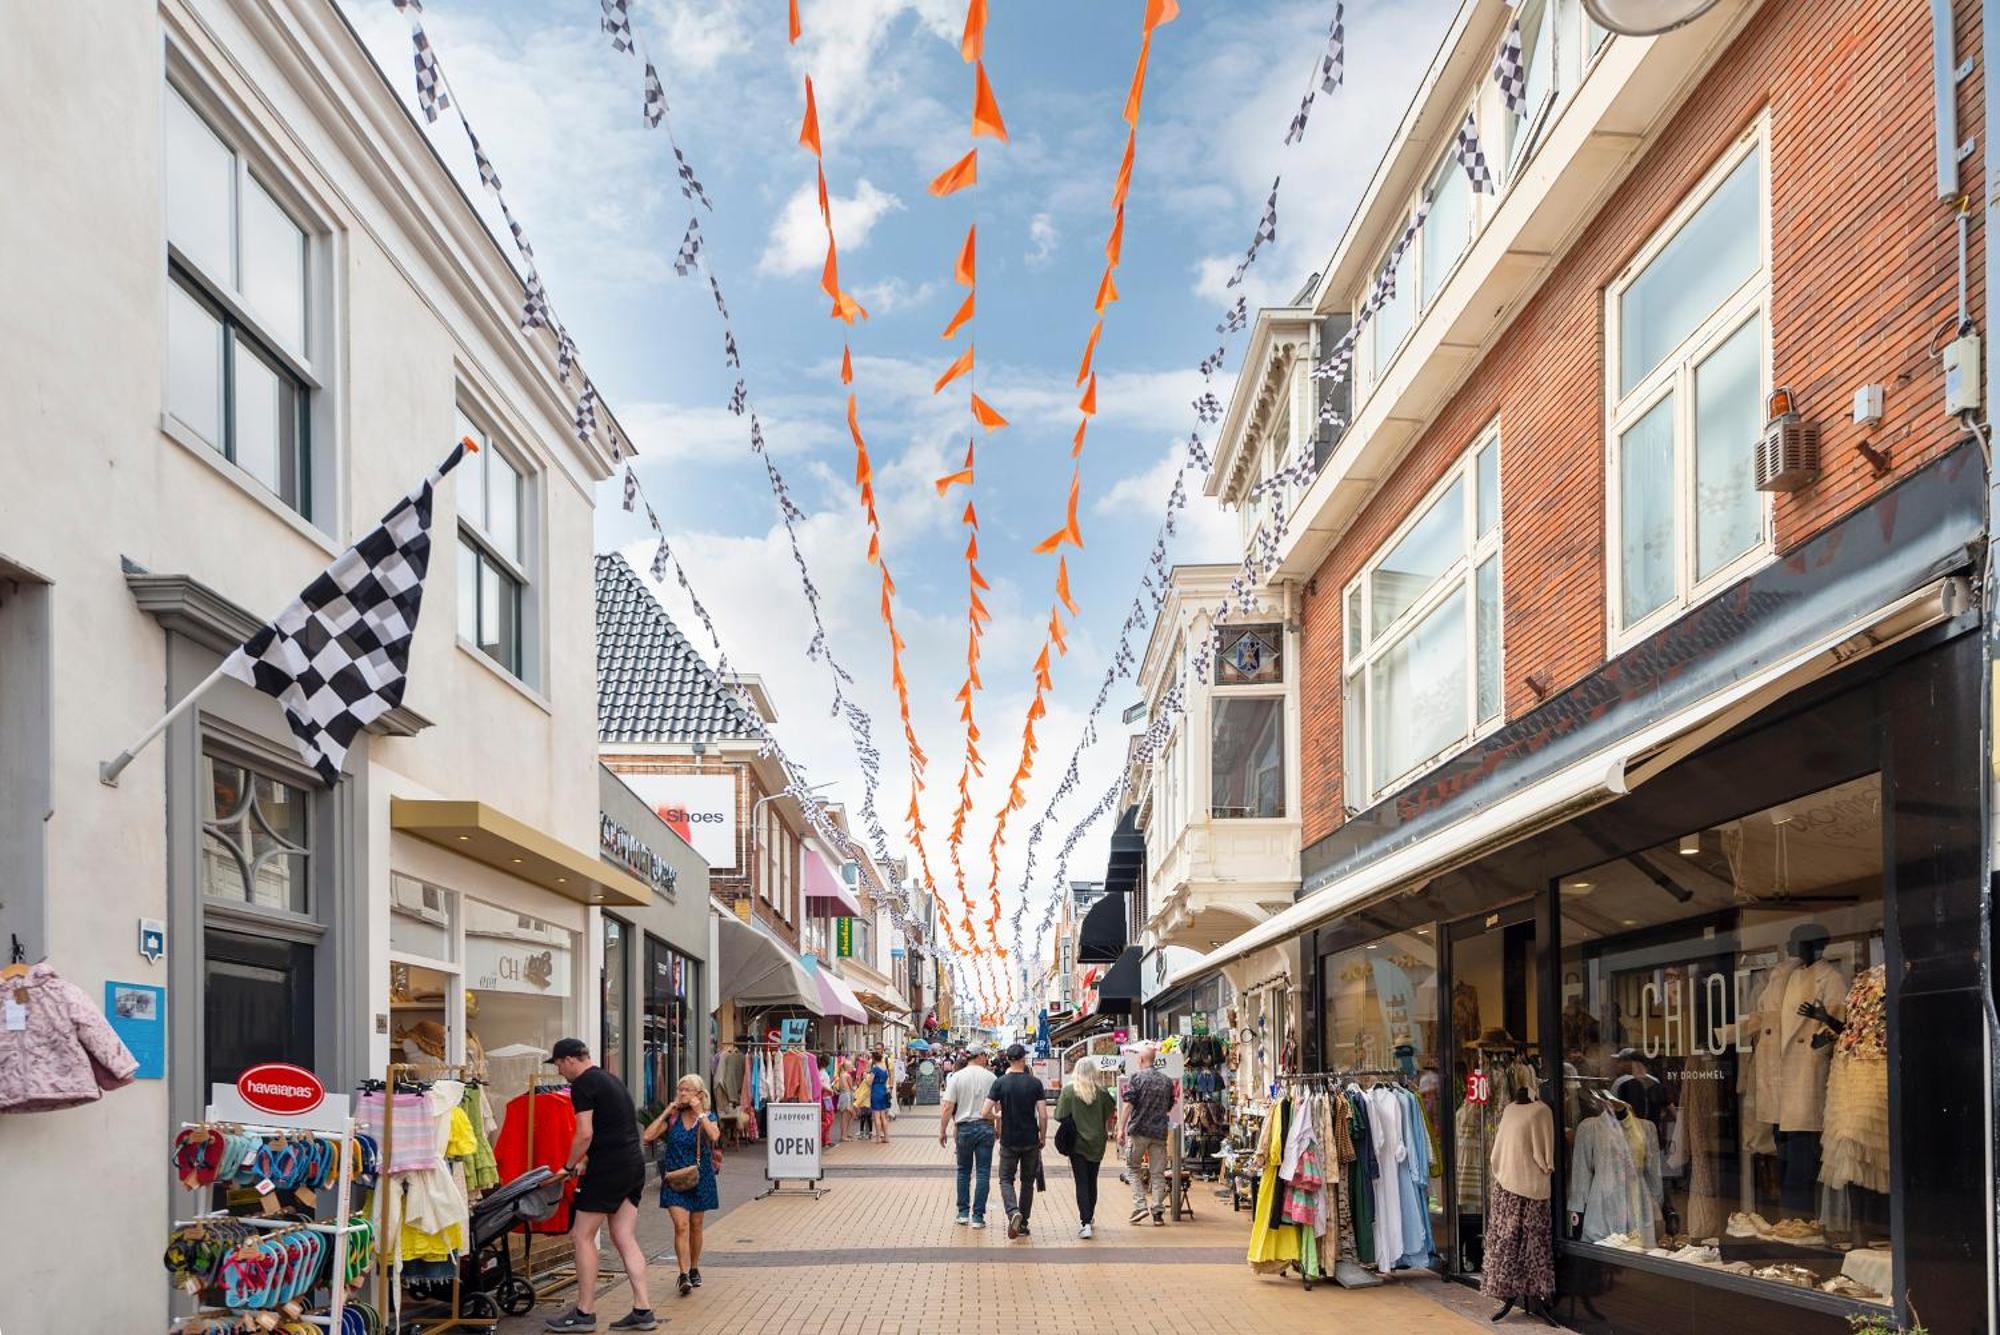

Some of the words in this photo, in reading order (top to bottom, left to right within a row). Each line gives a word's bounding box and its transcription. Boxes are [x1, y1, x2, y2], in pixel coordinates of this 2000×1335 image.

[666, 808, 724, 823] Shoes
[1642, 968, 1753, 1059] CHLOE
[1667, 1071, 1678, 1080] BY
[1680, 1070, 1725, 1080] DROMMEL
[247, 1080, 312, 1099] havaianas
[774, 1137, 815, 1155] OPEN
